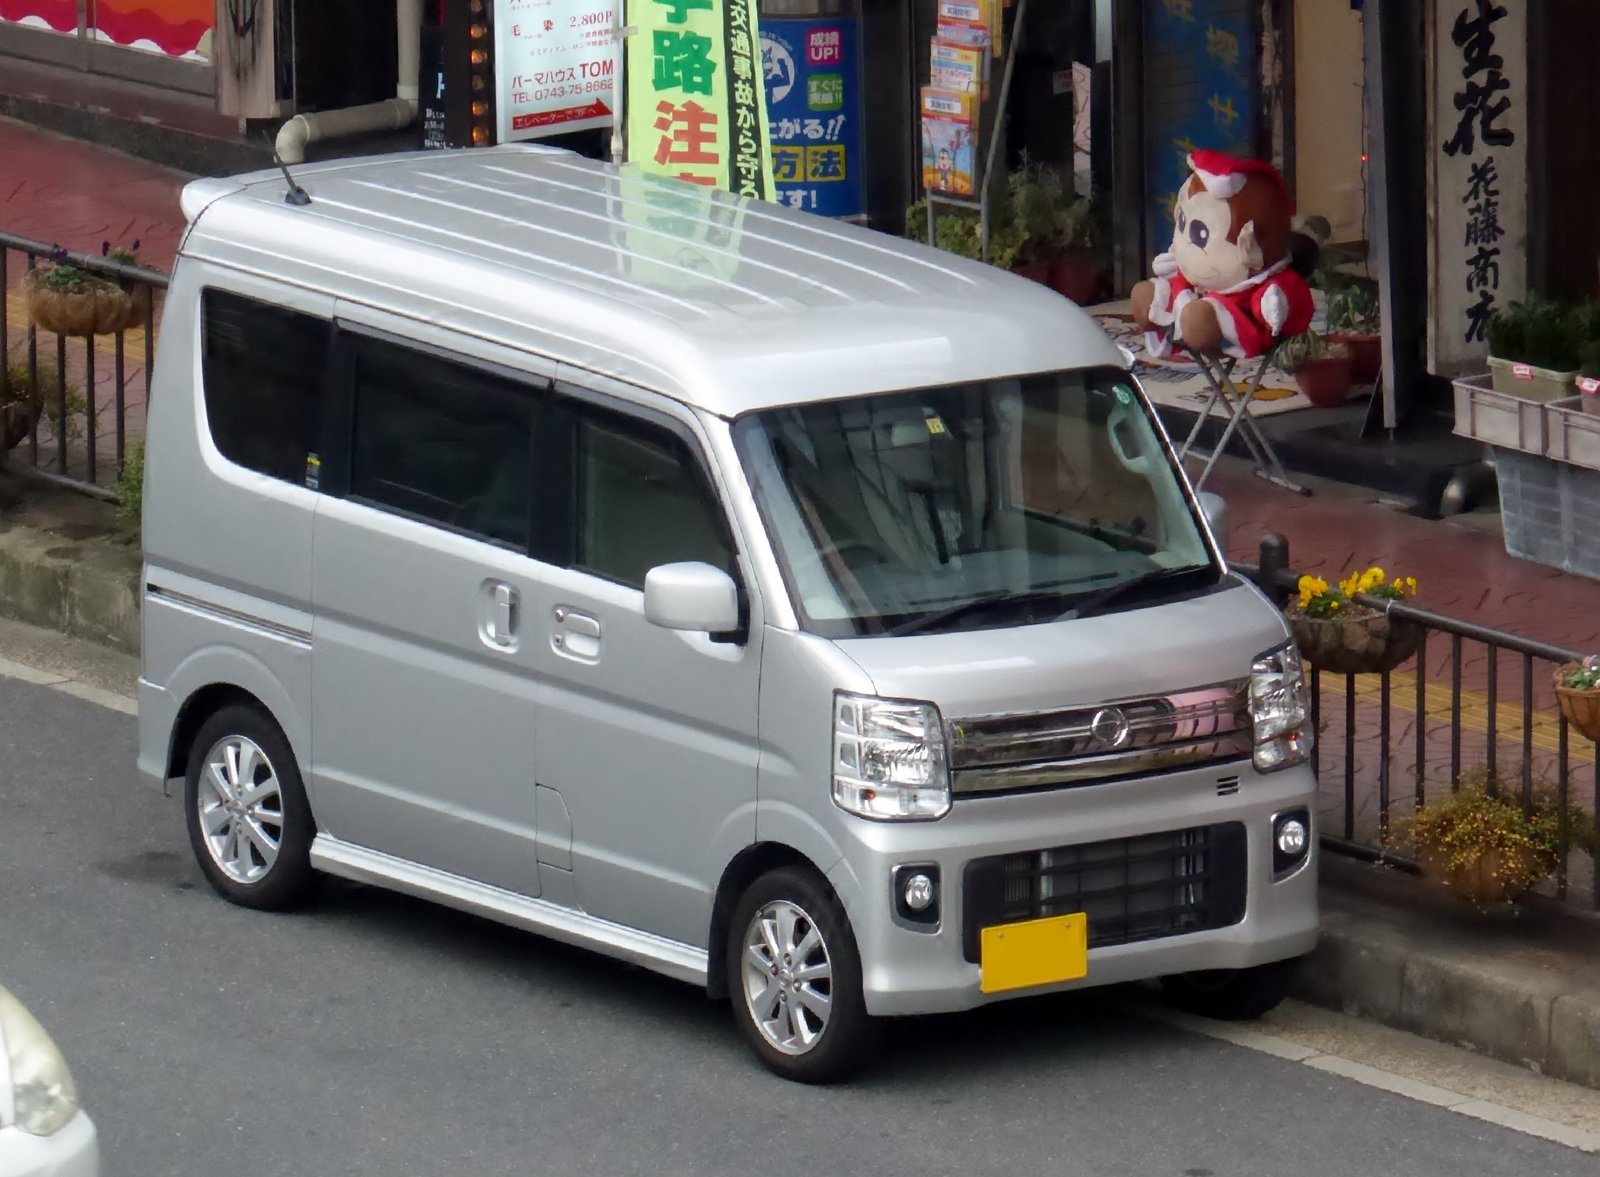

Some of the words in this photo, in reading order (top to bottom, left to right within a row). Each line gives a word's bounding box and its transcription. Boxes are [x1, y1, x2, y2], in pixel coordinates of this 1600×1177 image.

[811, 46, 839, 61] UP!
[580, 59, 613, 78] TOM
[1442, 0, 1514, 156] 生花
[650, 0, 720, 186] 路注
[808, 80, 842, 91] すぐに
[512, 93, 531, 104] TEL
[772, 151, 842, 178] 方法
